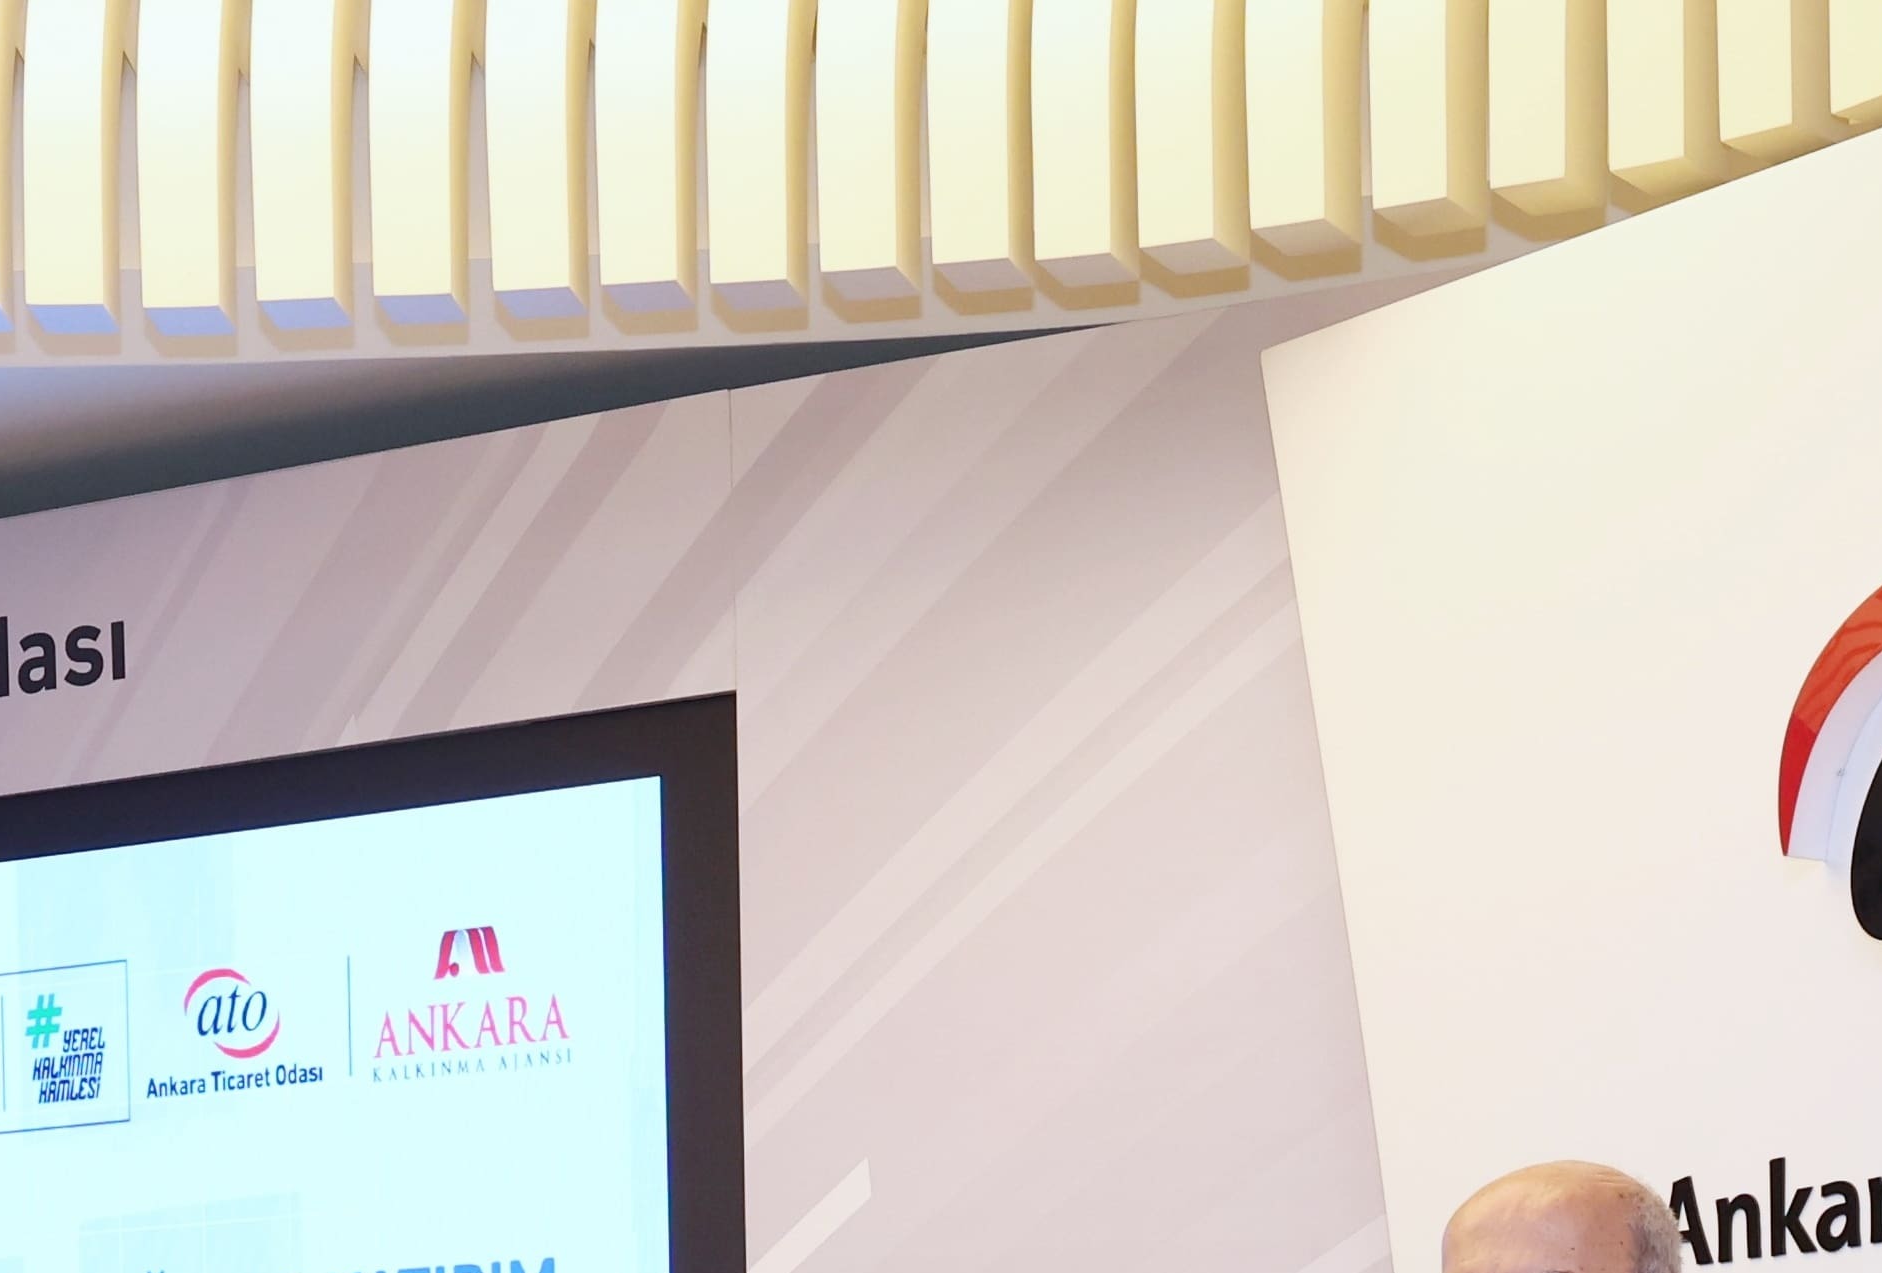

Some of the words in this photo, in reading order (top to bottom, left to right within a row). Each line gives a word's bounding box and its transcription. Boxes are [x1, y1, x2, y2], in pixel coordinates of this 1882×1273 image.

[197, 985, 268, 1037] ato
[374, 994, 571, 1058] ANKARA
[32, 1051, 104, 1081] KALKINMA
[145, 1075, 209, 1100] Ankara
[210, 1068, 275, 1095] Ticaret
[276, 1063, 324, 1088] Odası
[372, 1057, 486, 1083] KALKINMA
[498, 1047, 572, 1072] AJANSI
